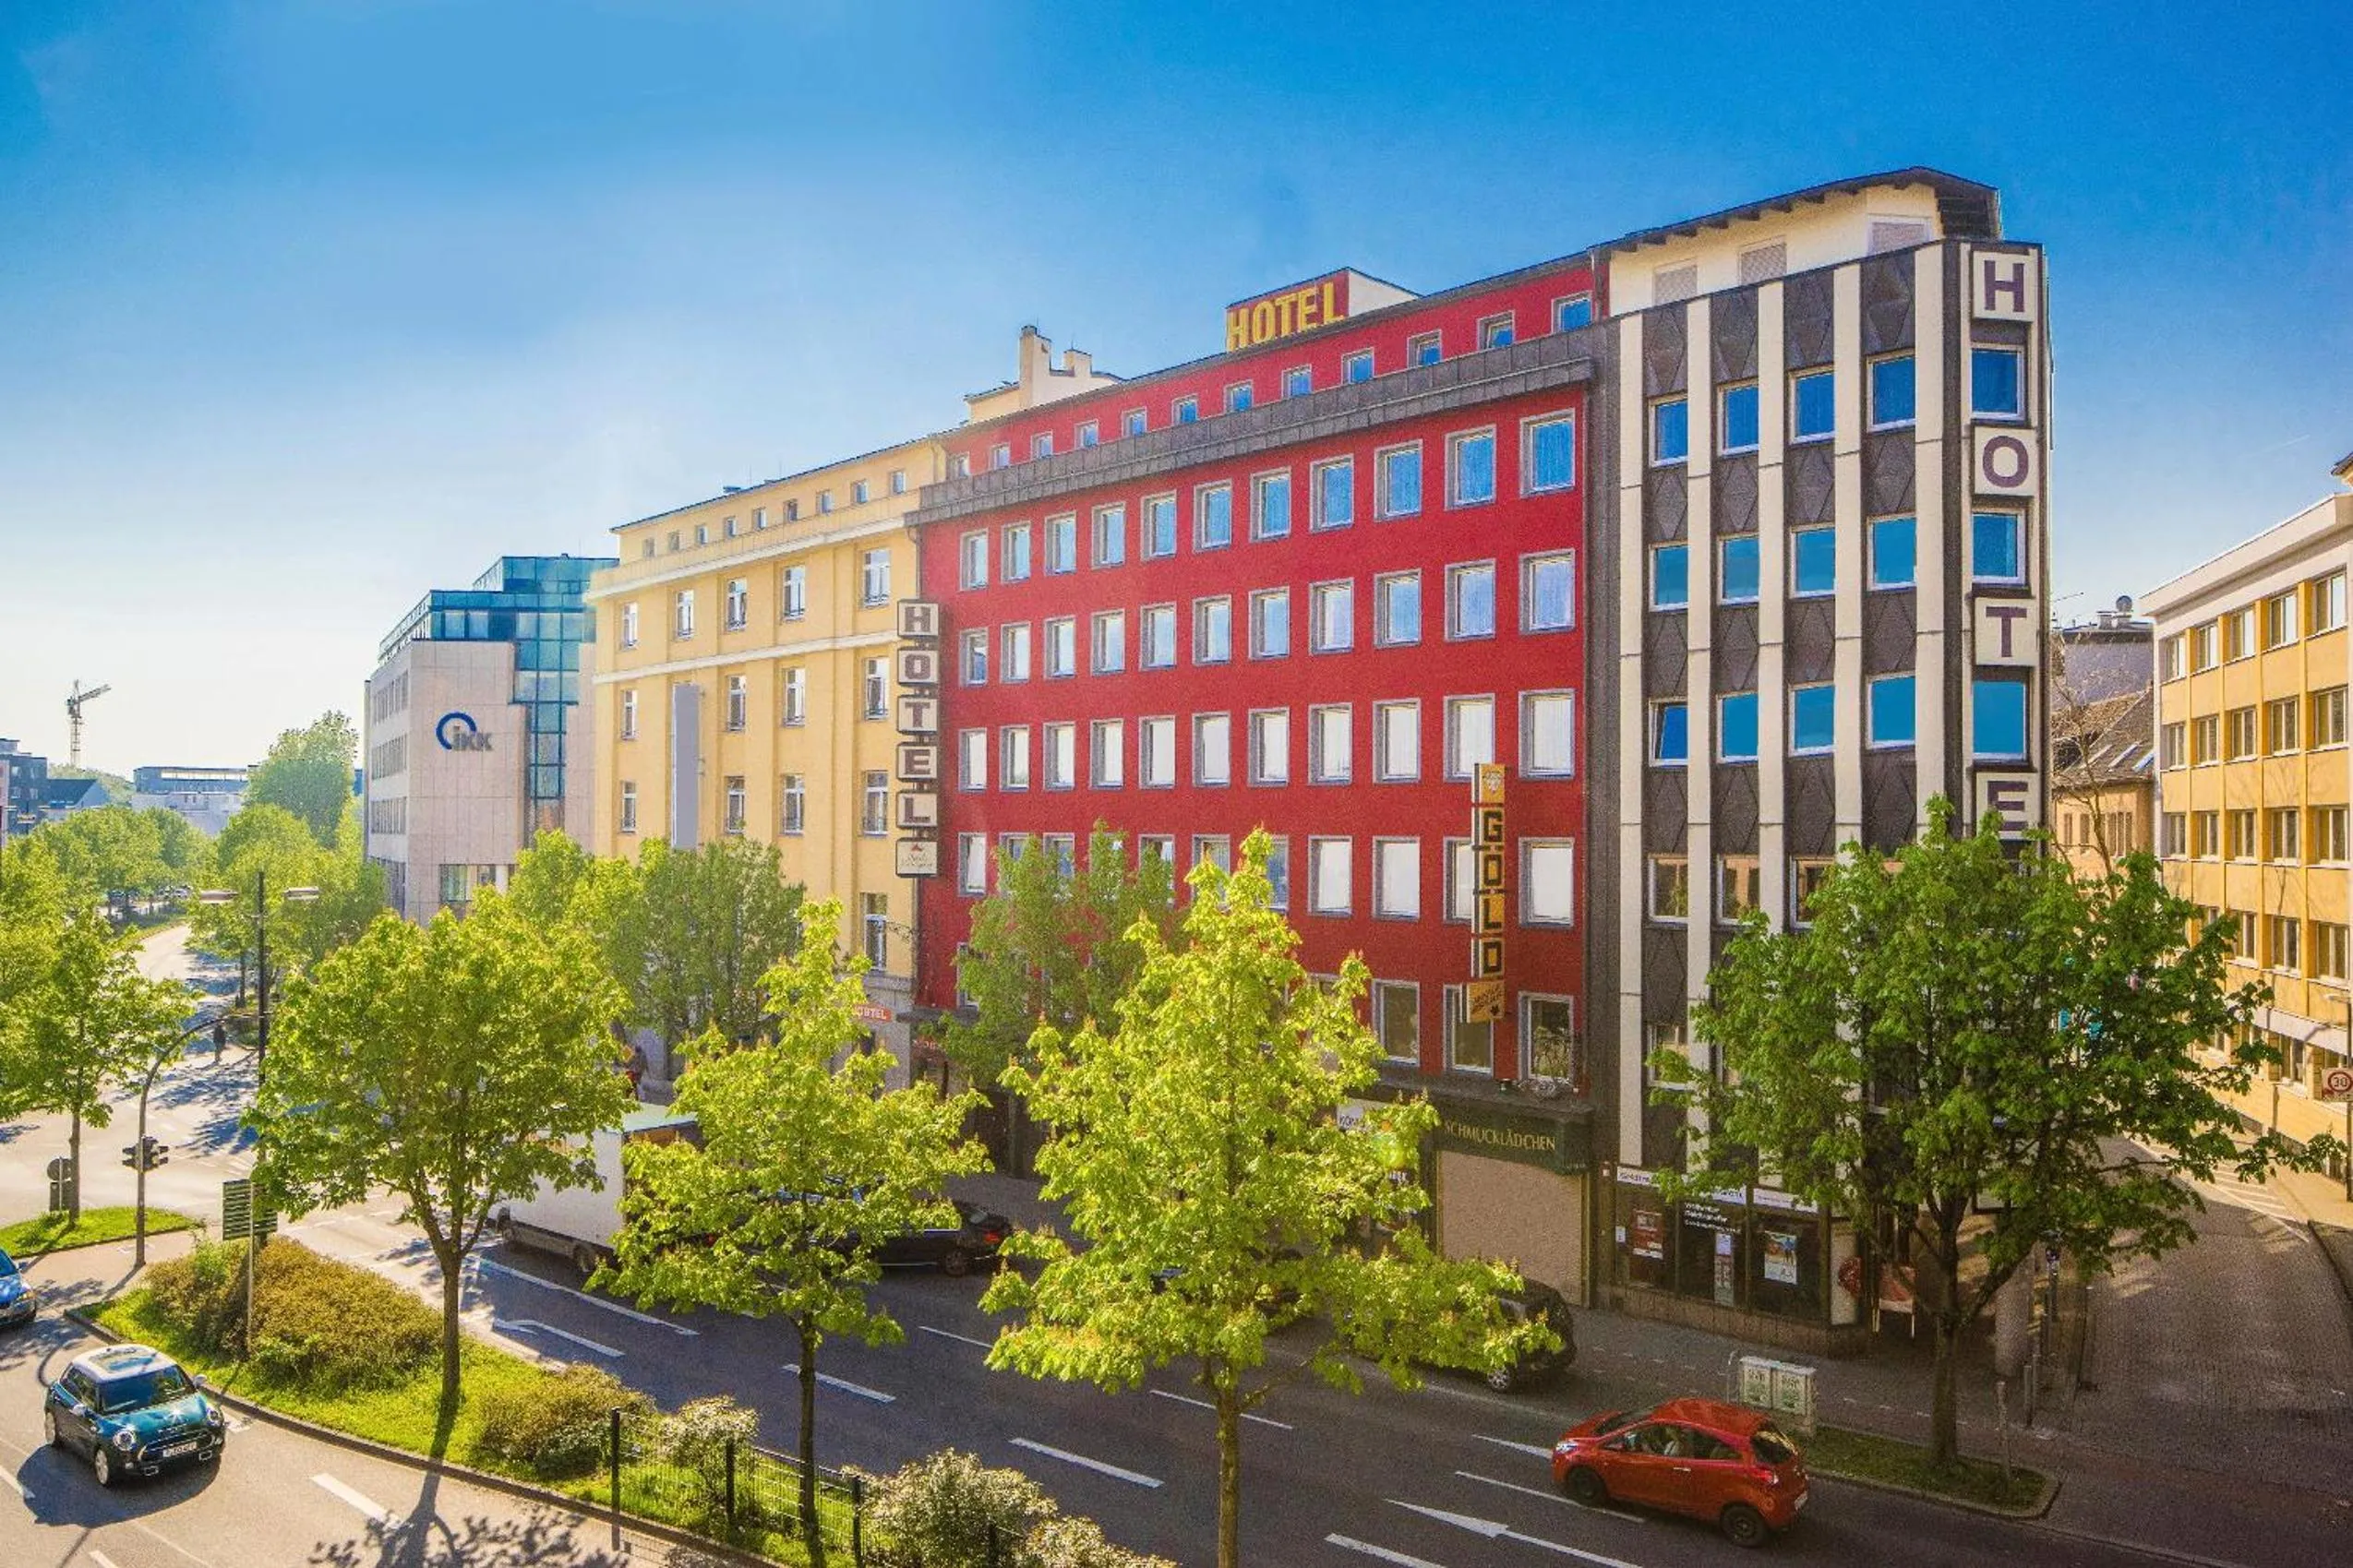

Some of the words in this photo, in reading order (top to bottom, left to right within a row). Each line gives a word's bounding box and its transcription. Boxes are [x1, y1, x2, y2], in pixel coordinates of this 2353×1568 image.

[1226, 281, 1344, 352] HOTEL
[1983, 260, 2029, 830] HOTE
[904, 605, 930, 823] HOTEL
